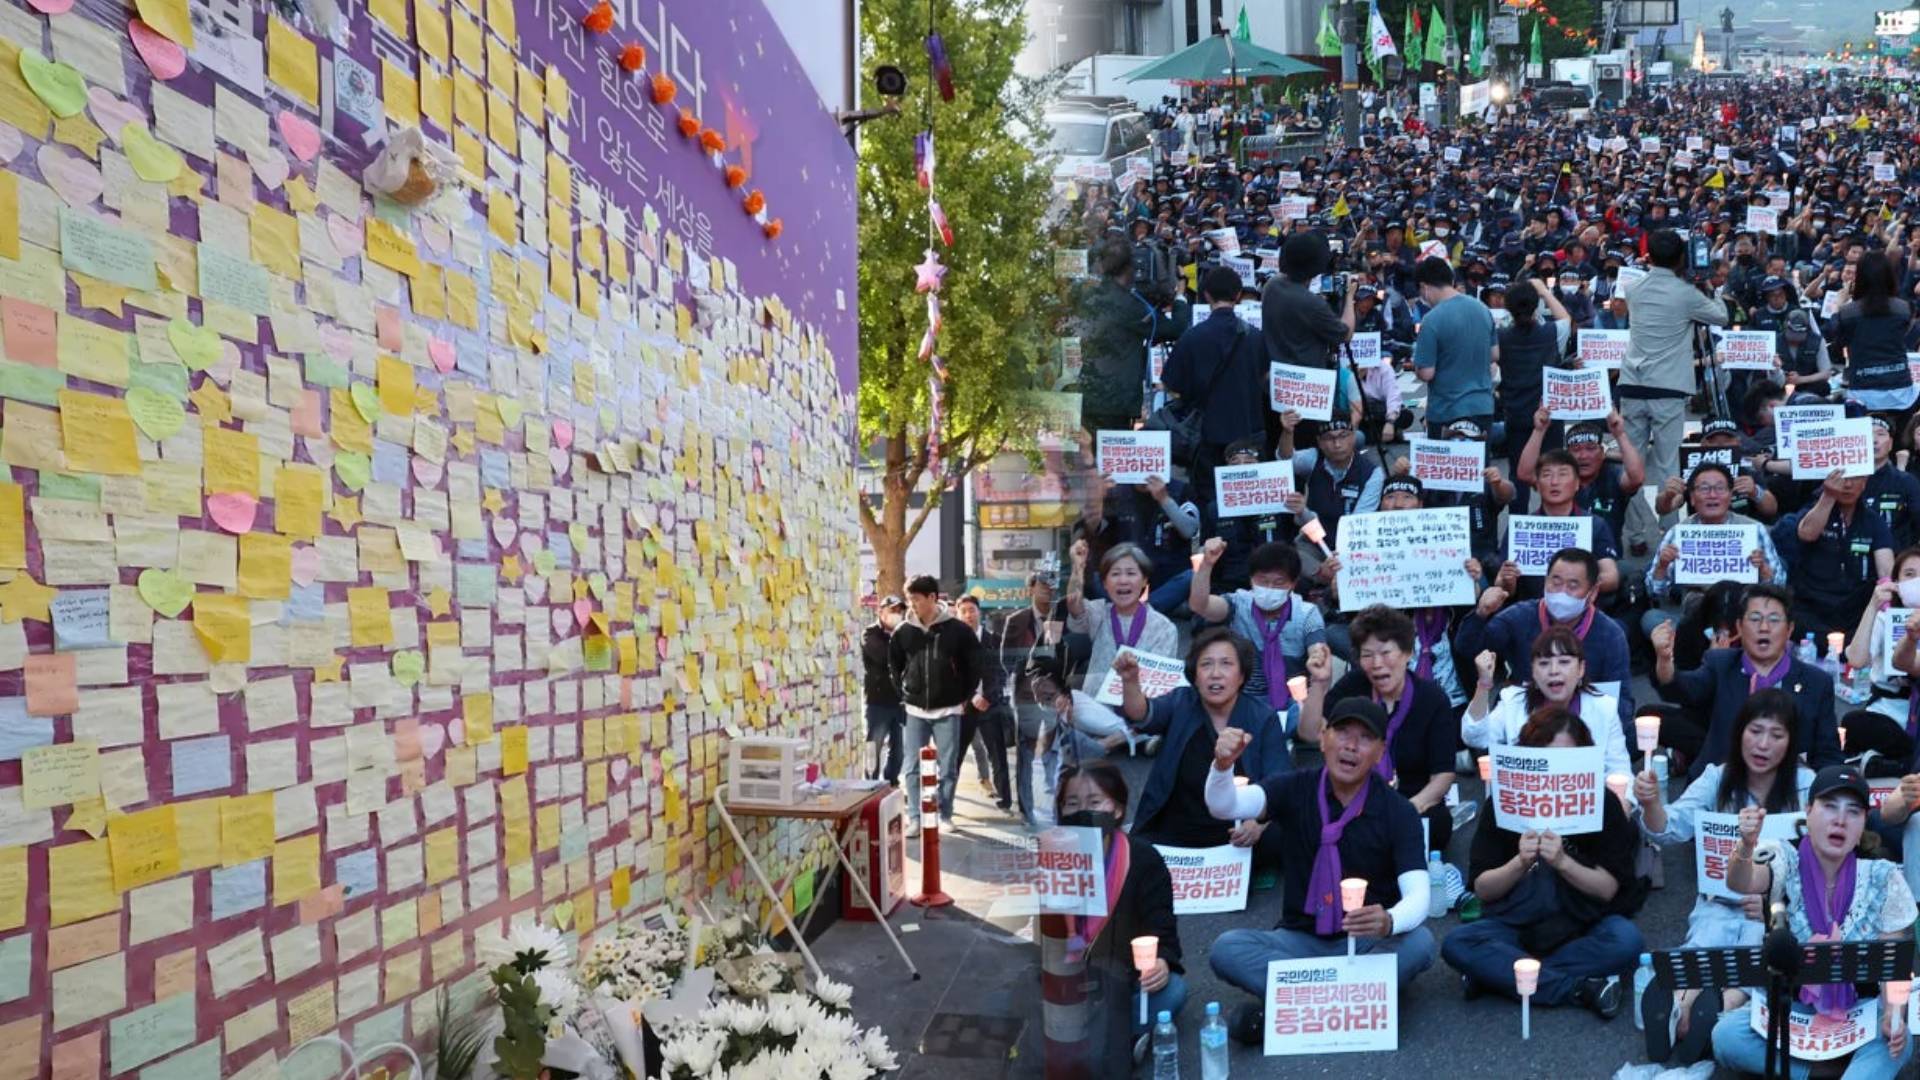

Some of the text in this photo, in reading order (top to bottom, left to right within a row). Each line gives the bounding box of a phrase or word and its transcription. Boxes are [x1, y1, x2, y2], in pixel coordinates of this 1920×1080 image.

[595, 46, 668, 153] 힘으로
[598, 116, 648, 197] 않는
[655, 175, 714, 256] 세상을
[1582, 348, 1626, 361] 동참하라
[1547, 380, 1601, 398] 대통령은
[1274, 388, 1329, 410] 동참하라!
[1547, 394, 1606, 412] 공식사과!
[1102, 457, 1165, 474] 동참하라!
[1798, 449, 1868, 470] 동참하라!
[1415, 464, 1480, 482] 동참하라!
[1514, 531, 1577, 548] 특별법을
[1680, 530, 1702, 539] 10.29
[1681, 539, 1743, 556] 특별법을
[1681, 557, 1750, 574] 제정하라!
[1495, 755, 1549, 772] 국민의힘은
[1497, 769, 1595, 792] 특별법제정에
[1498, 789, 1595, 818] 동참하라!
[1172, 878, 1241, 900] 참하라!
[1276, 968, 1339, 985] 국민의힘은
[1275, 981, 1388, 1005] 특별법제정에
[1274, 1003, 1388, 1036] 동참하라!
